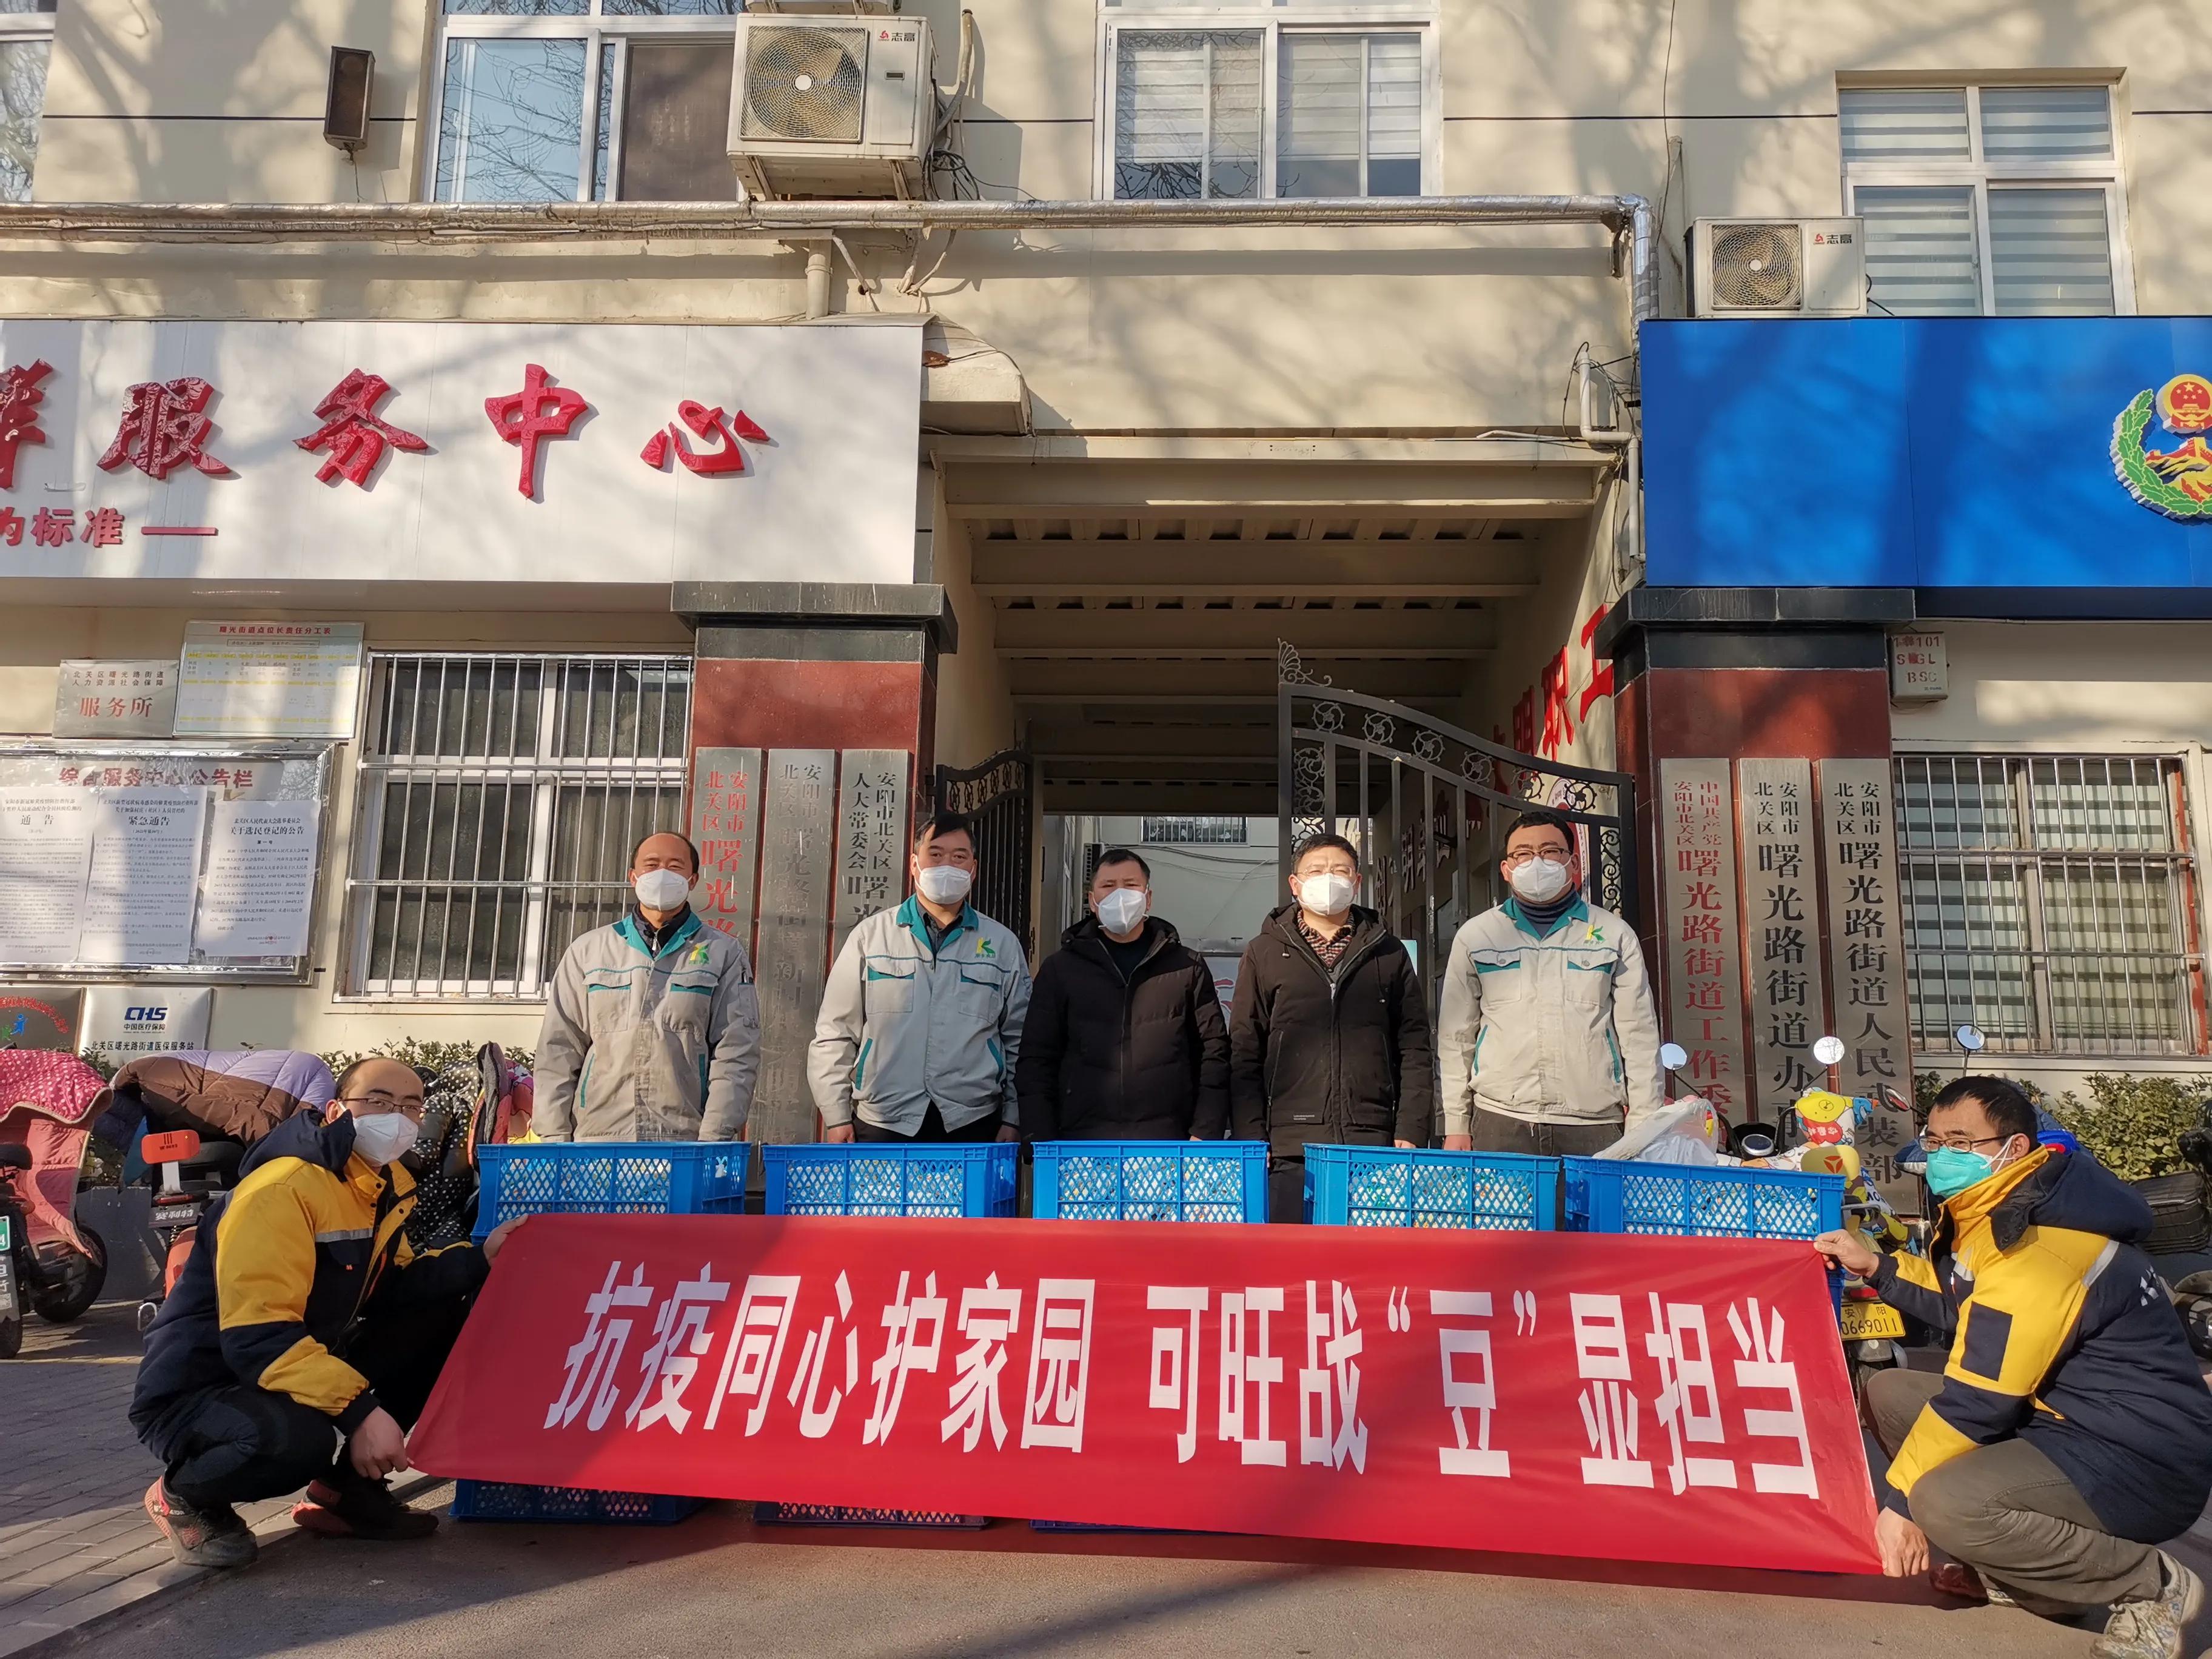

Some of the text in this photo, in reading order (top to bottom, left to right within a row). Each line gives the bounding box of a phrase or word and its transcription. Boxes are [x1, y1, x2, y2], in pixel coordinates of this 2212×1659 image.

[891, 33, 916, 42] 志高
[1826, 234, 1852, 244] 志高
[79, 697, 153, 718] 服务所
[702, 771, 723, 833] 北关区
[727, 771, 748, 833] 安阳市
[802, 764, 822, 818] 安阳市
[1674, 782, 1695, 845] 安阳市北关区
[1700, 782, 1722, 845] 中国共产党
[1754, 782, 1775, 835] 北关区
[1780, 782, 1800, 835] 安阳市
[1834, 782, 1855, 835] 北关区
[1860, 782, 1881, 835] 安阳市
[129, 816, 170, 825] 紧急通告
[231, 826, 304, 835] 关于选民登记的公告
[848, 773, 870, 869] 人大常委会
[873, 772, 896, 870] 安阳市北关区
[124, 1007, 168, 1021] CHS
[91, 1040, 194, 1051] 北关区曙光路街道医保服务站
[1845, 1306, 1886, 1318] 安阳
[543, 1261, 1095, 1454] 抗疫同心护家园
